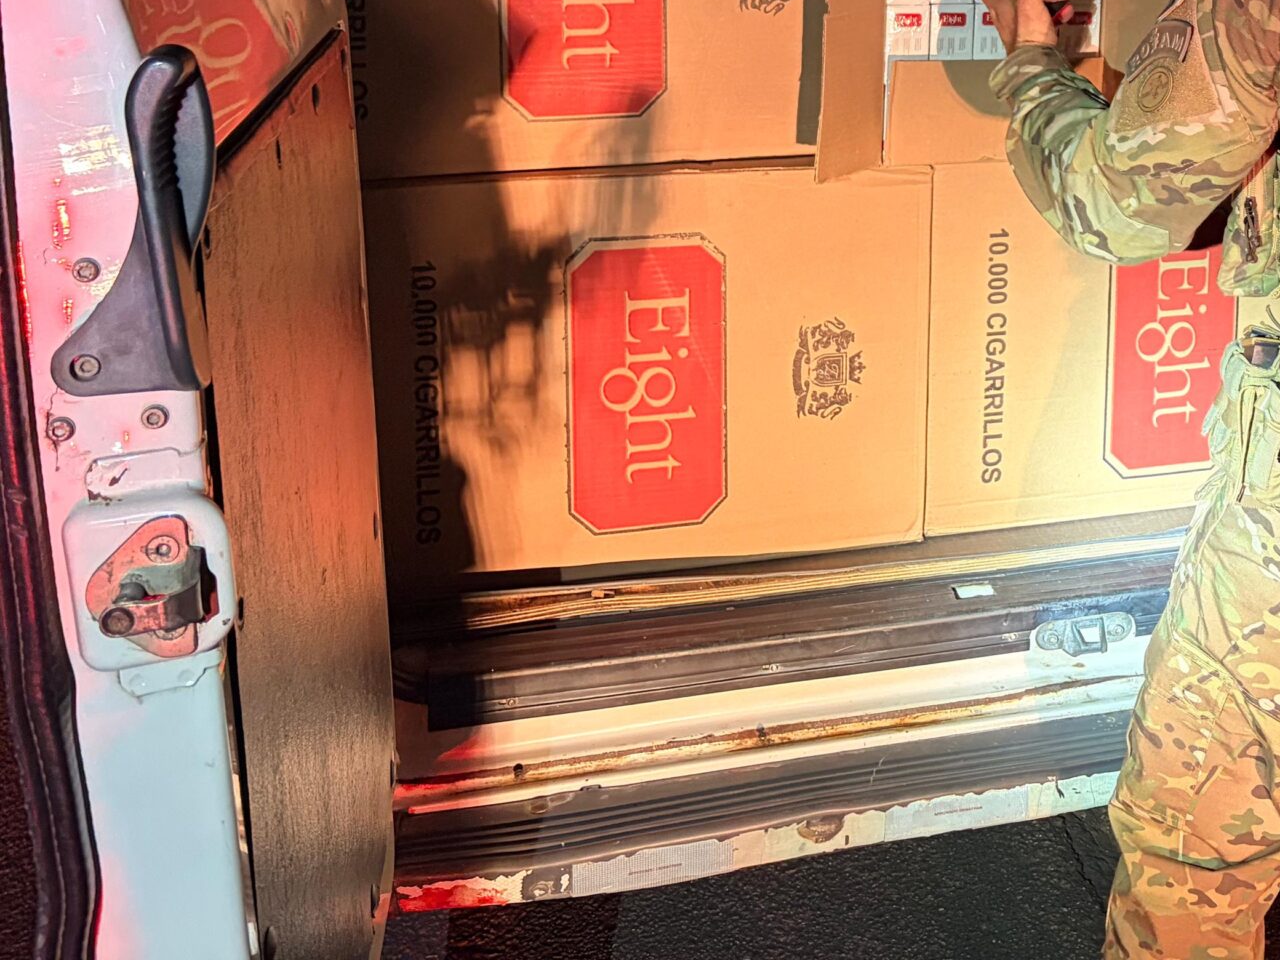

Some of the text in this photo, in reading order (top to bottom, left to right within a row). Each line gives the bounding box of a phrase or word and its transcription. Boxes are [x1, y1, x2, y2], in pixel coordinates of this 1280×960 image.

[942, 14, 964, 25] Eight
[410, 259, 442, 546] 10.000 CIGARRILLOS
[598, 287, 699, 485] Eight
[981, 227, 1010, 485] 10.000 CIGARRILLOS
[1135, 250, 1212, 429] Eight
